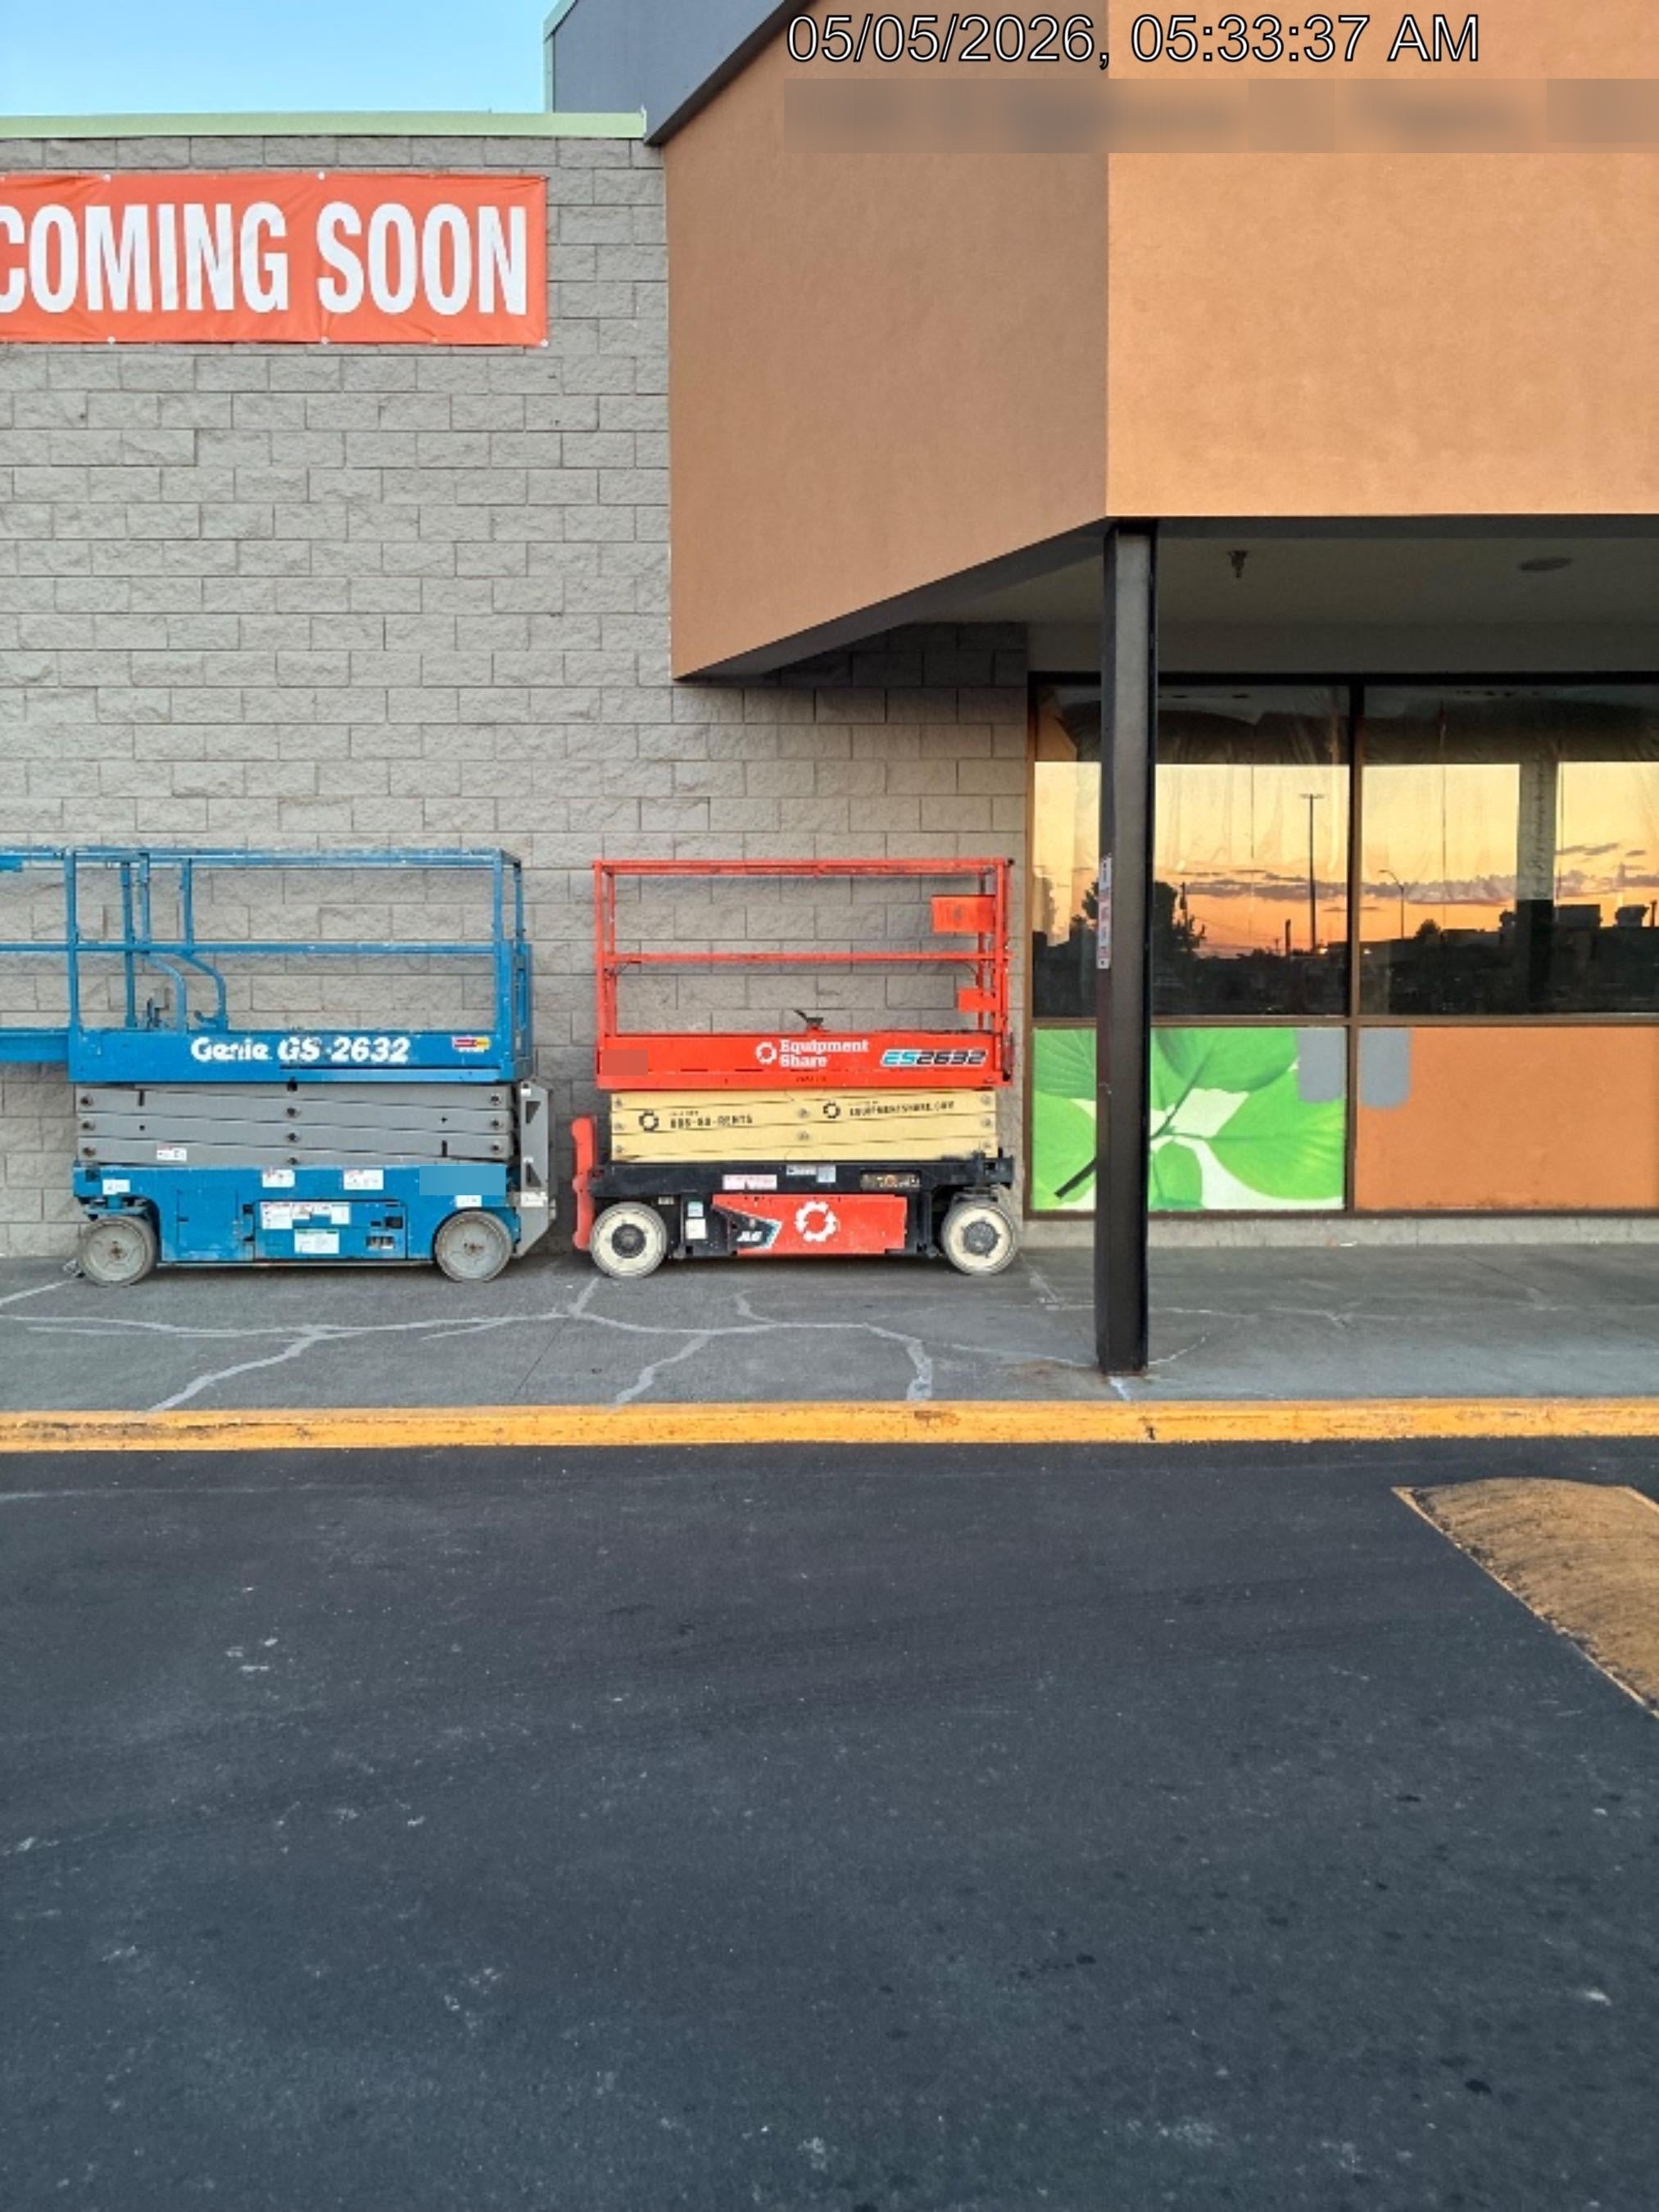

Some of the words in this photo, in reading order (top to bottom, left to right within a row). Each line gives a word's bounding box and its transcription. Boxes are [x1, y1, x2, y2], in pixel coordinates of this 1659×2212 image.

[316, 202, 527, 315] SOON
[191, 1036, 269, 1061] Genie
[781, 1040, 868, 1055] Equipment
[781, 1054, 827, 1067] Share
[882, 1049, 986, 1066] ES2632
